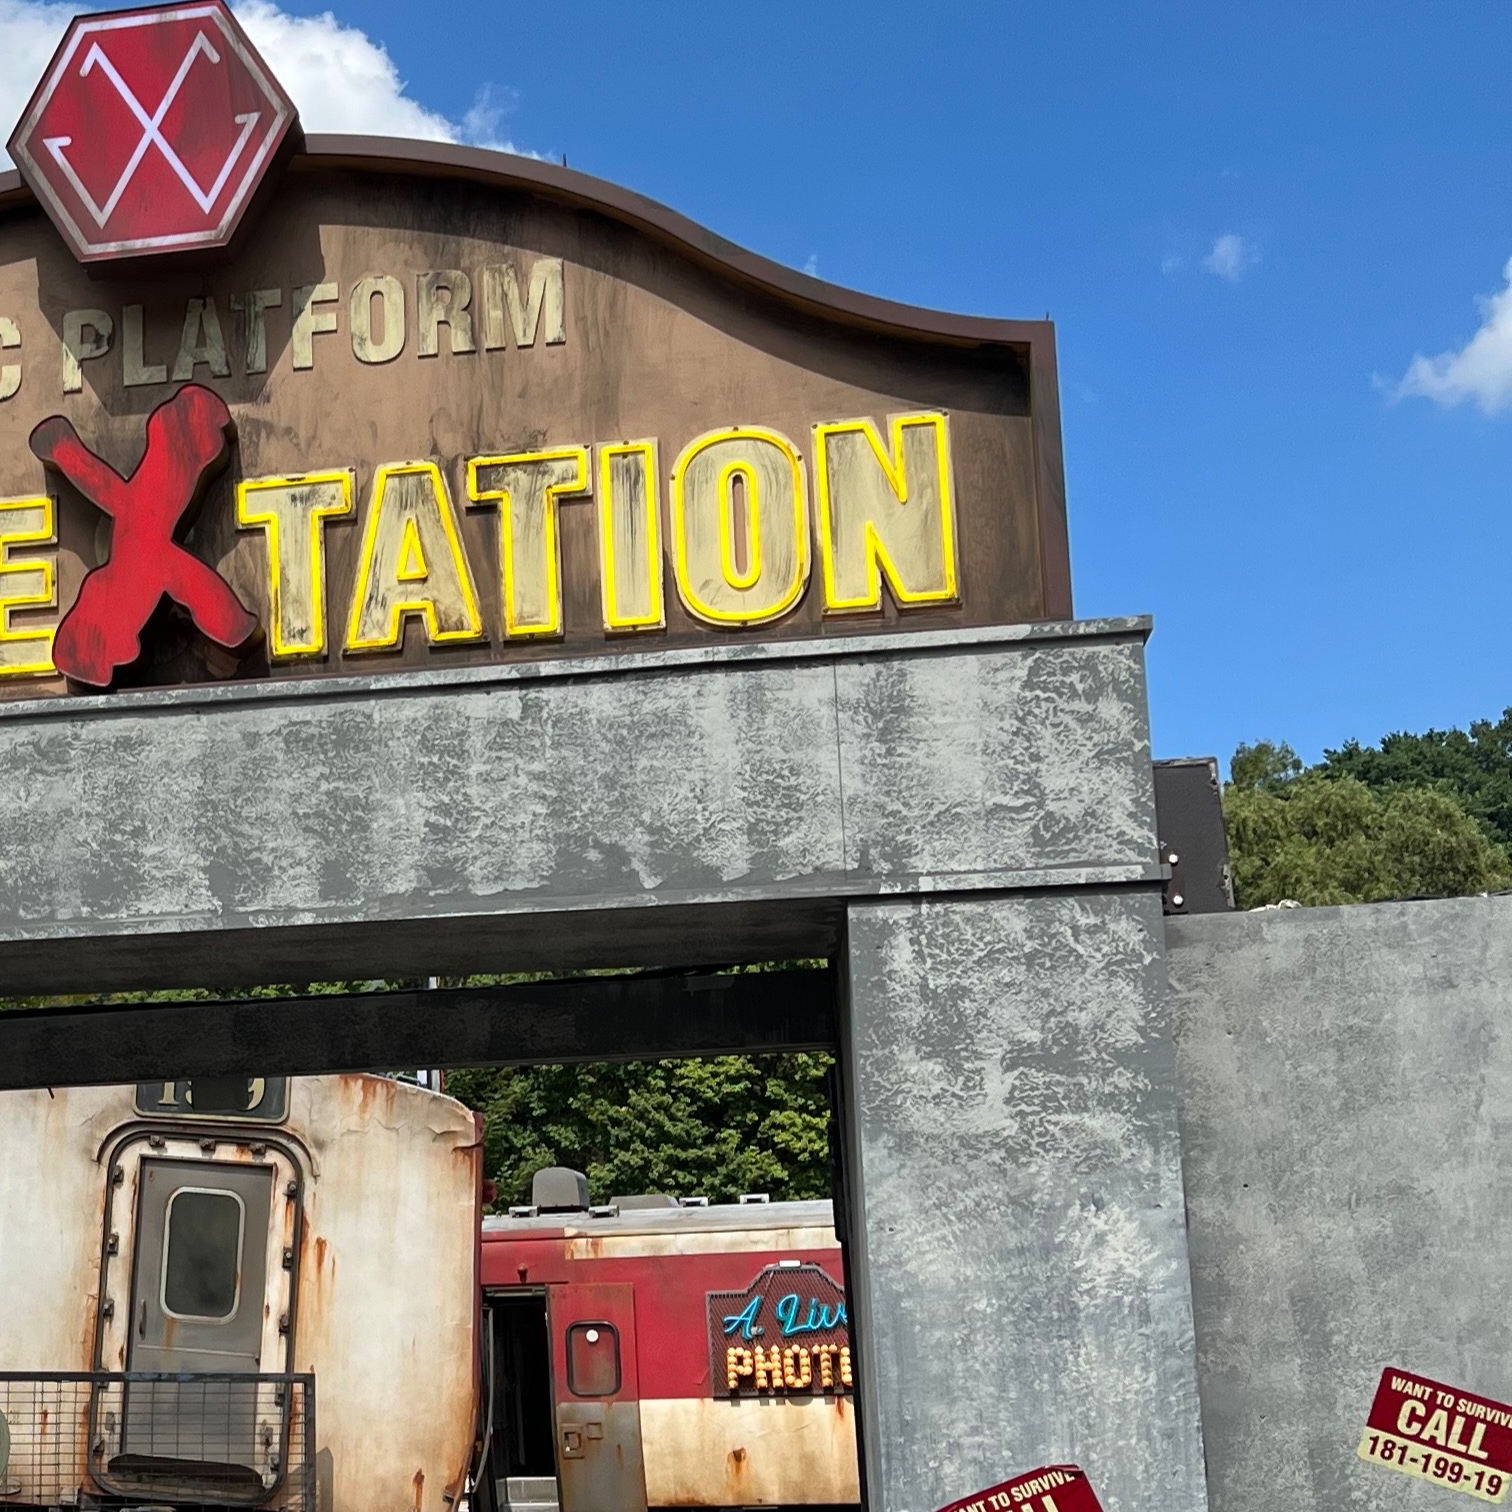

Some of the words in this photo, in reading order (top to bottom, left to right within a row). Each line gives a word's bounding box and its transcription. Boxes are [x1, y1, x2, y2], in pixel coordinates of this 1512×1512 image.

[62, 257, 568, 393] PLATFORM
[776, 1294, 848, 1336] Liv
[1391, 1376, 1433, 1401] WANT
[1436, 1391, 1454, 1408] TO
[1397, 1399, 1488, 1460] CALL
[988, 1491, 1010, 1510] TO
[1011, 1471, 1075, 1502] SURVIVE
[1369, 1435, 1502, 1496] 181-199-19
